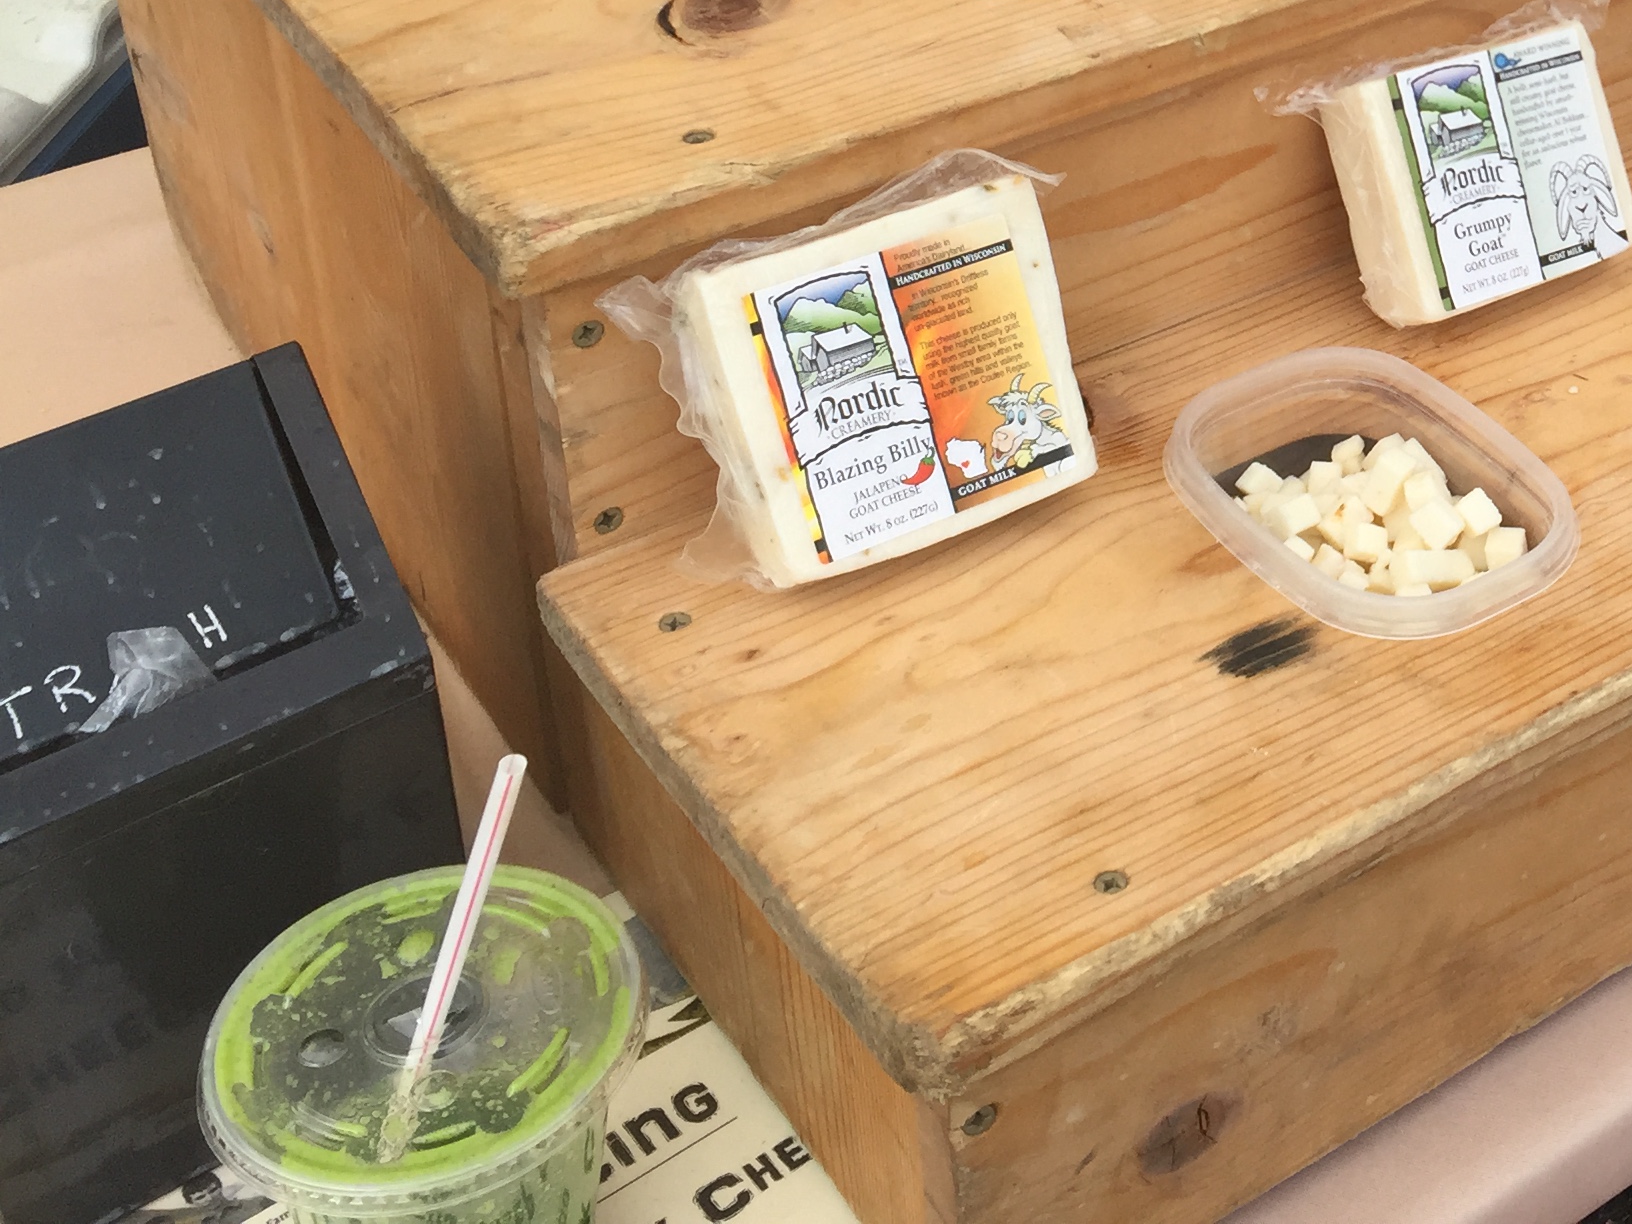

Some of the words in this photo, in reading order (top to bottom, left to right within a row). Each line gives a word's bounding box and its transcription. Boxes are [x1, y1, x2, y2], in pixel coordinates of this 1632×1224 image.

[1440, 159, 1506, 199] Nordic
[1452, 184, 1498, 205] CREAMERY
[1453, 212, 1513, 241] Grumpy
[893, 248, 920, 261] Proudly
[922, 240, 942, 253] made
[943, 239, 951, 247] in
[1464, 260, 1487, 274] GOAT
[1488, 248, 1520, 266] CHEESE
[1468, 236, 1505, 258] Goat
[1548, 250, 1566, 263] GOAT
[1566, 245, 1585, 258] MILK
[895, 262, 952, 287] HANDCRAFTED
[952, 257, 962, 268] IN
[962, 243, 1007, 264] WISCONSIN
[1491, 275, 1497, 286] 8
[936, 330, 961, 345] cheese
[969, 316, 1001, 334] produced
[1002, 311, 1017, 322] only
[942, 344, 954, 354] the
[955, 334, 980, 349] highest
[1003, 321, 1021, 334] goat
[957, 346, 976, 358] small
[1013, 341, 1024, 350] the
[985, 360, 999, 372] and
[967, 379, 979, 389] the
[814, 381, 904, 437] Nordic
[831, 409, 893, 440] CREAMERY
[814, 457, 888, 491] Blazing
[888, 435, 935, 464] Billy
[853, 473, 909, 504] JALAPENO
[958, 478, 988, 497] GOAT
[988, 467, 1017, 486] MILK
[849, 498, 880, 520] GOAT
[881, 483, 922, 508] CHEESE
[885, 518, 893, 530] 8
[0, 603, 228, 739] TRH
